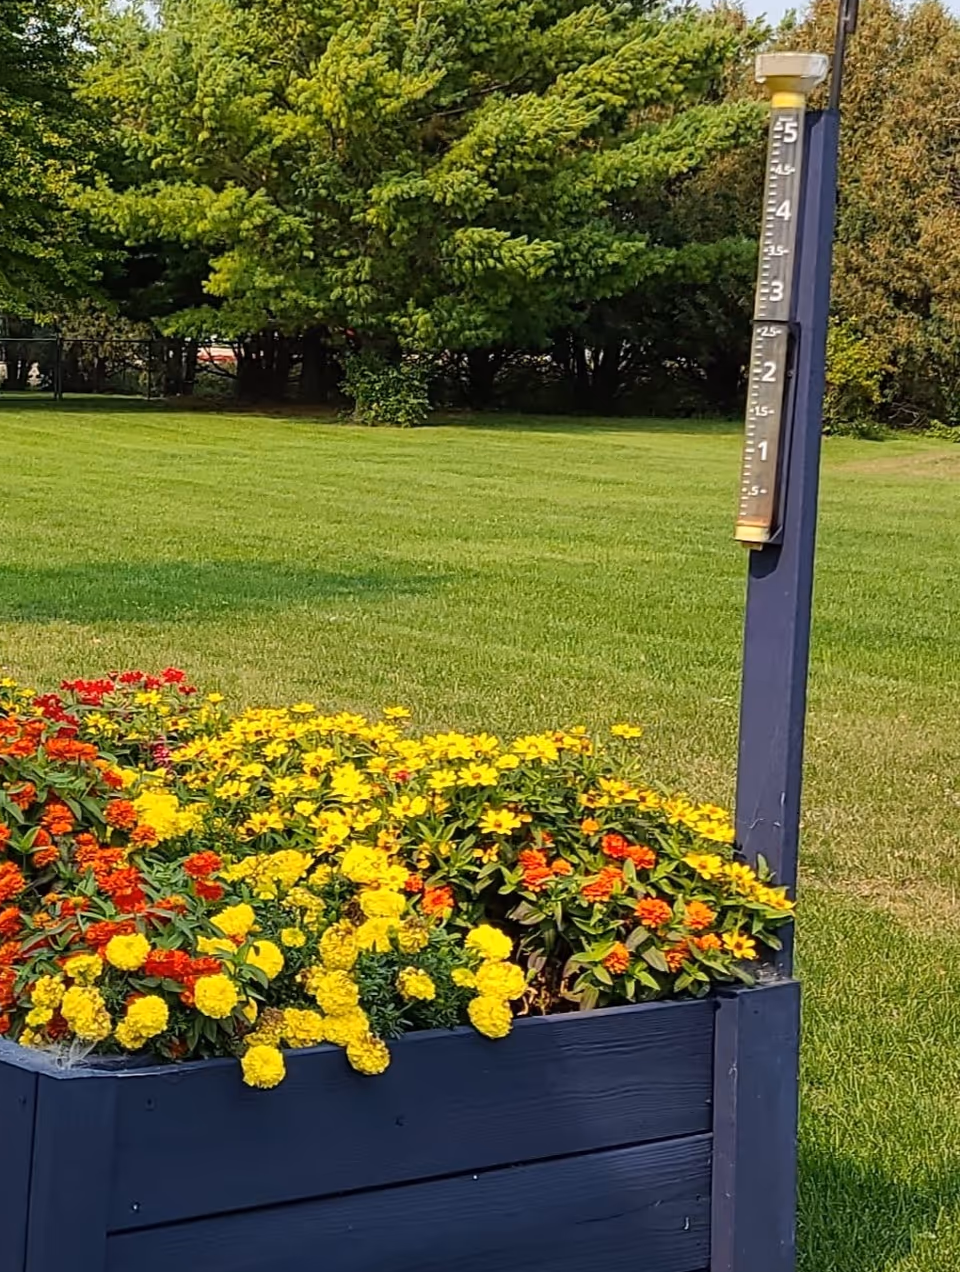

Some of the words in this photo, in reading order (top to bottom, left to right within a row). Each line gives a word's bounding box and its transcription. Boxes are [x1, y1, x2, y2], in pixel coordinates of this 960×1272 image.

[783, 122, 798, 143] 5
[775, 199, 791, 221] 4
[769, 281, 784, 302] 3
[761, 361, 777, 382] 2
[757, 440, 768, 461] 1
